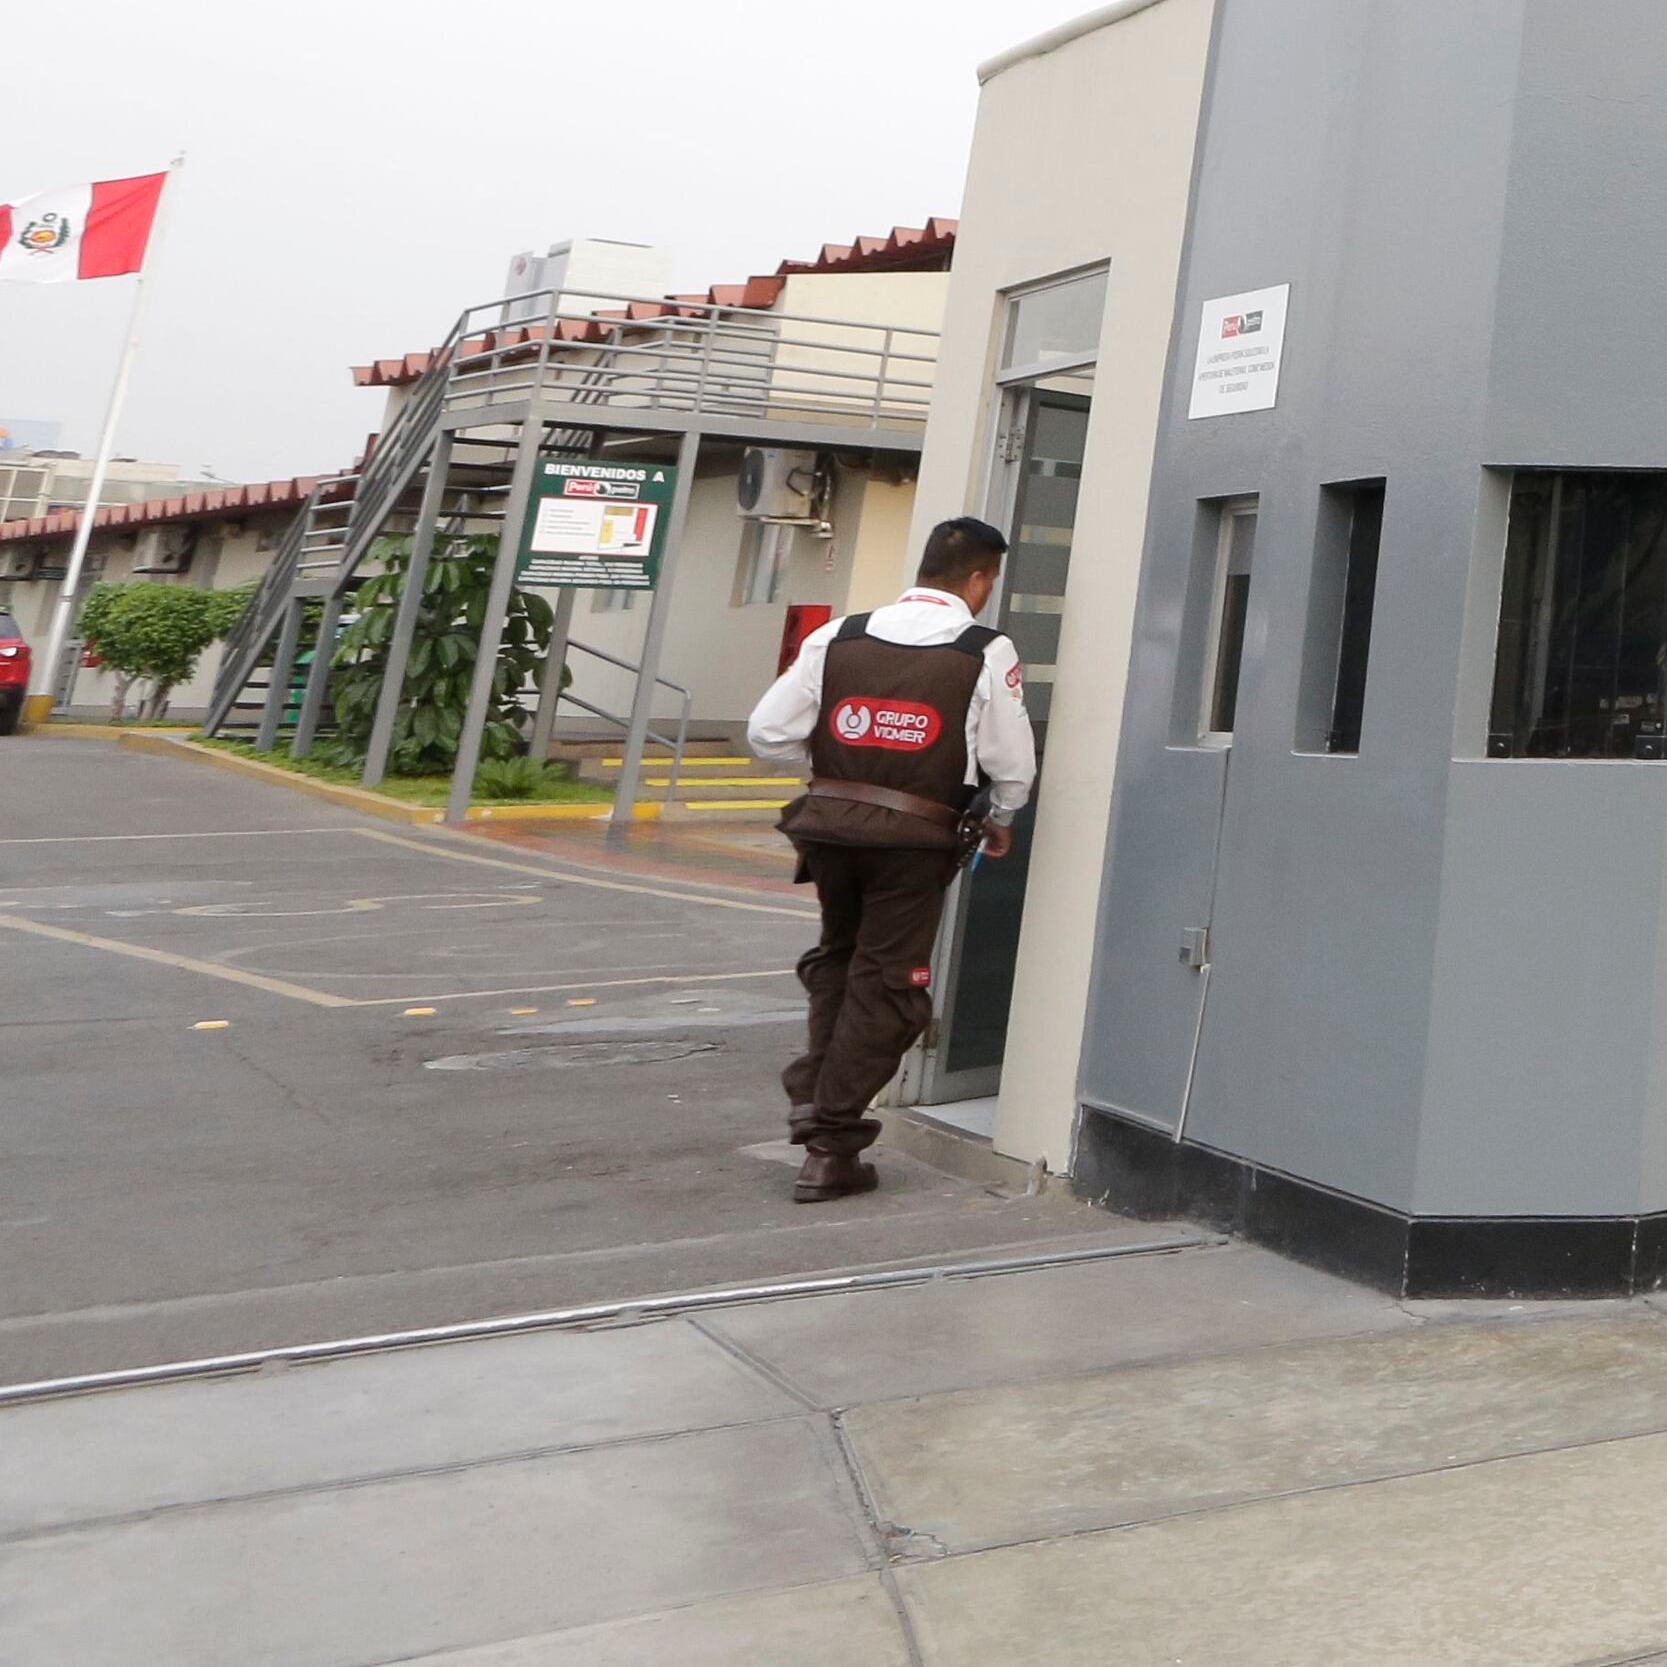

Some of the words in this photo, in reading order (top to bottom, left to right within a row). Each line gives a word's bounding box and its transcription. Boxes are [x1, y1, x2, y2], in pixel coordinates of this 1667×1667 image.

[544, 463, 647, 482] BIENVENIDOS
[652, 471, 665, 483] A
[876, 710, 929, 729] GRUPO
[873, 725, 927, 744] VIDMER
